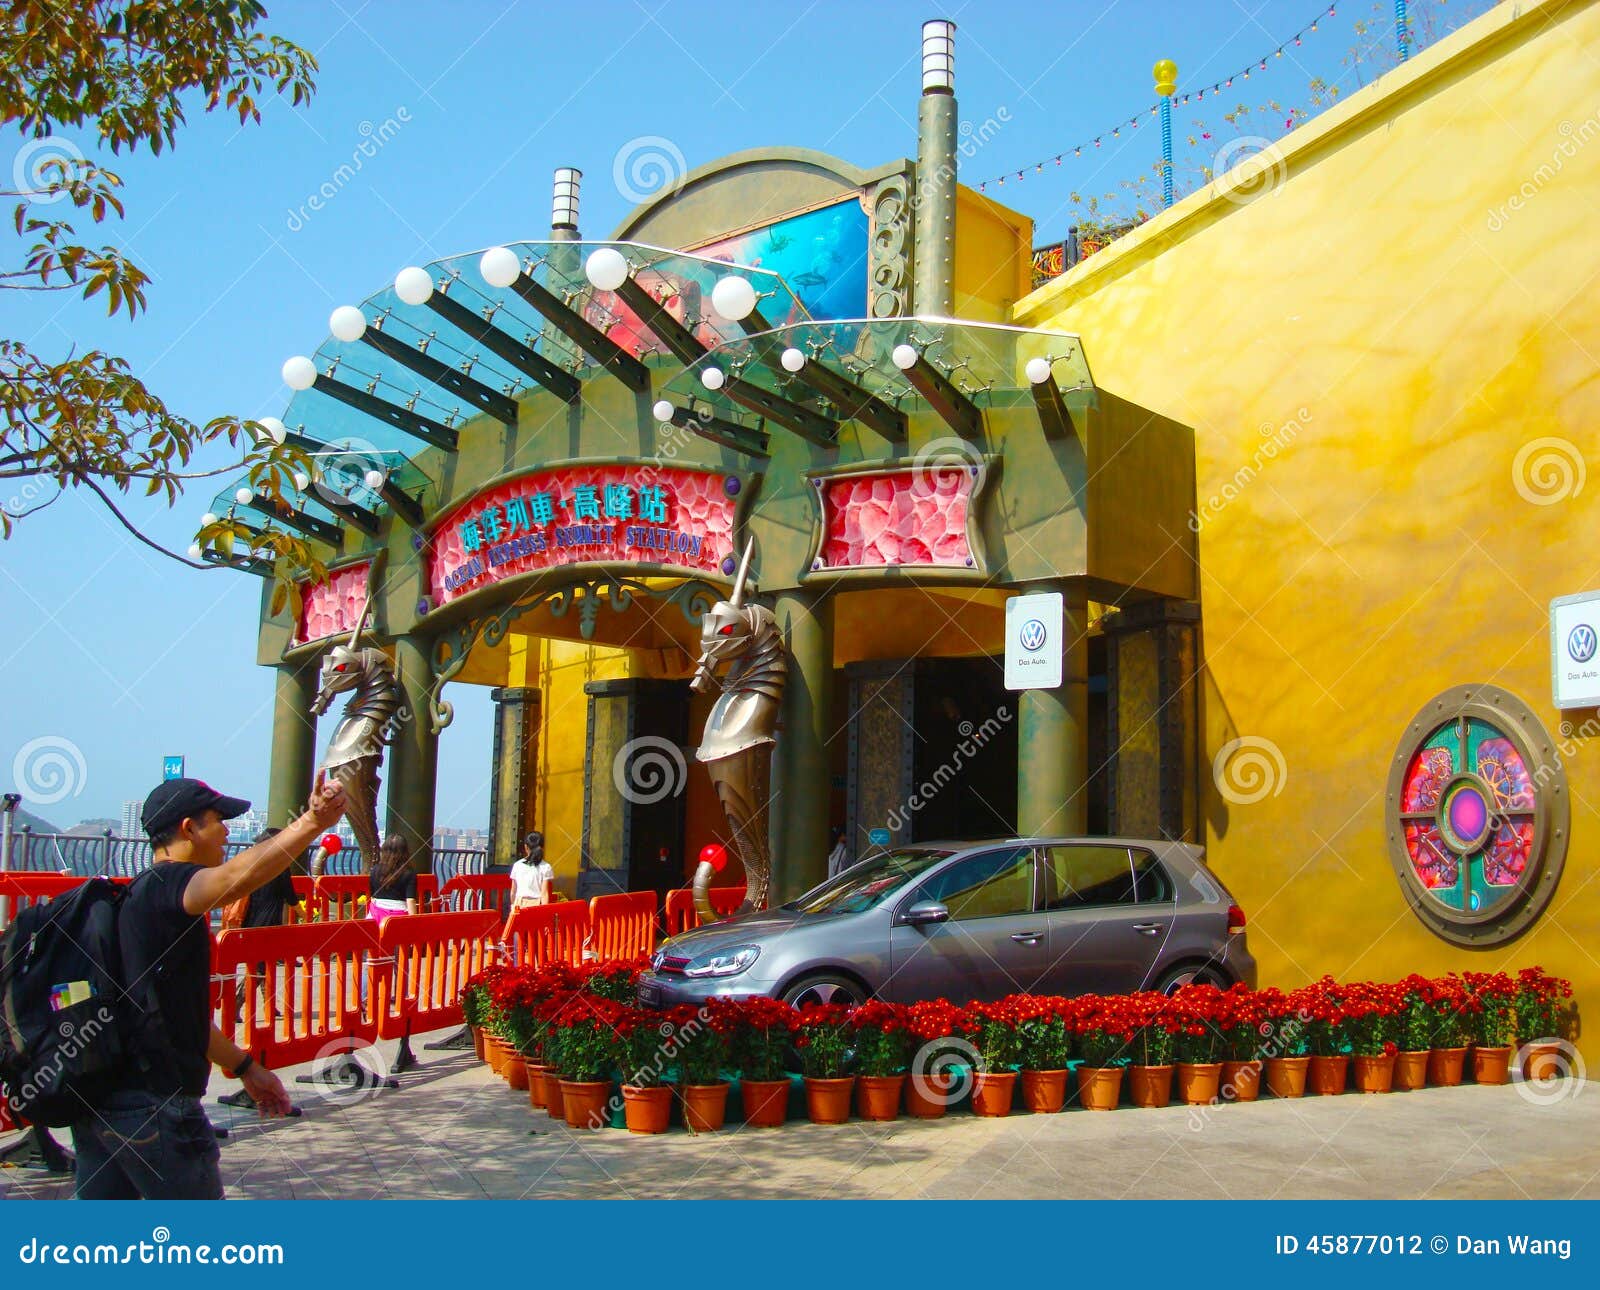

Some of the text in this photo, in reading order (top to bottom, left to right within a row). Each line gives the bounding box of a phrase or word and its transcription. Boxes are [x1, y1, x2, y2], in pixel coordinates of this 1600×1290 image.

[445, 524, 702, 592] OCEAN EXPRESS SUMMIT STATION
[1567, 672, 1581, 680] Das
